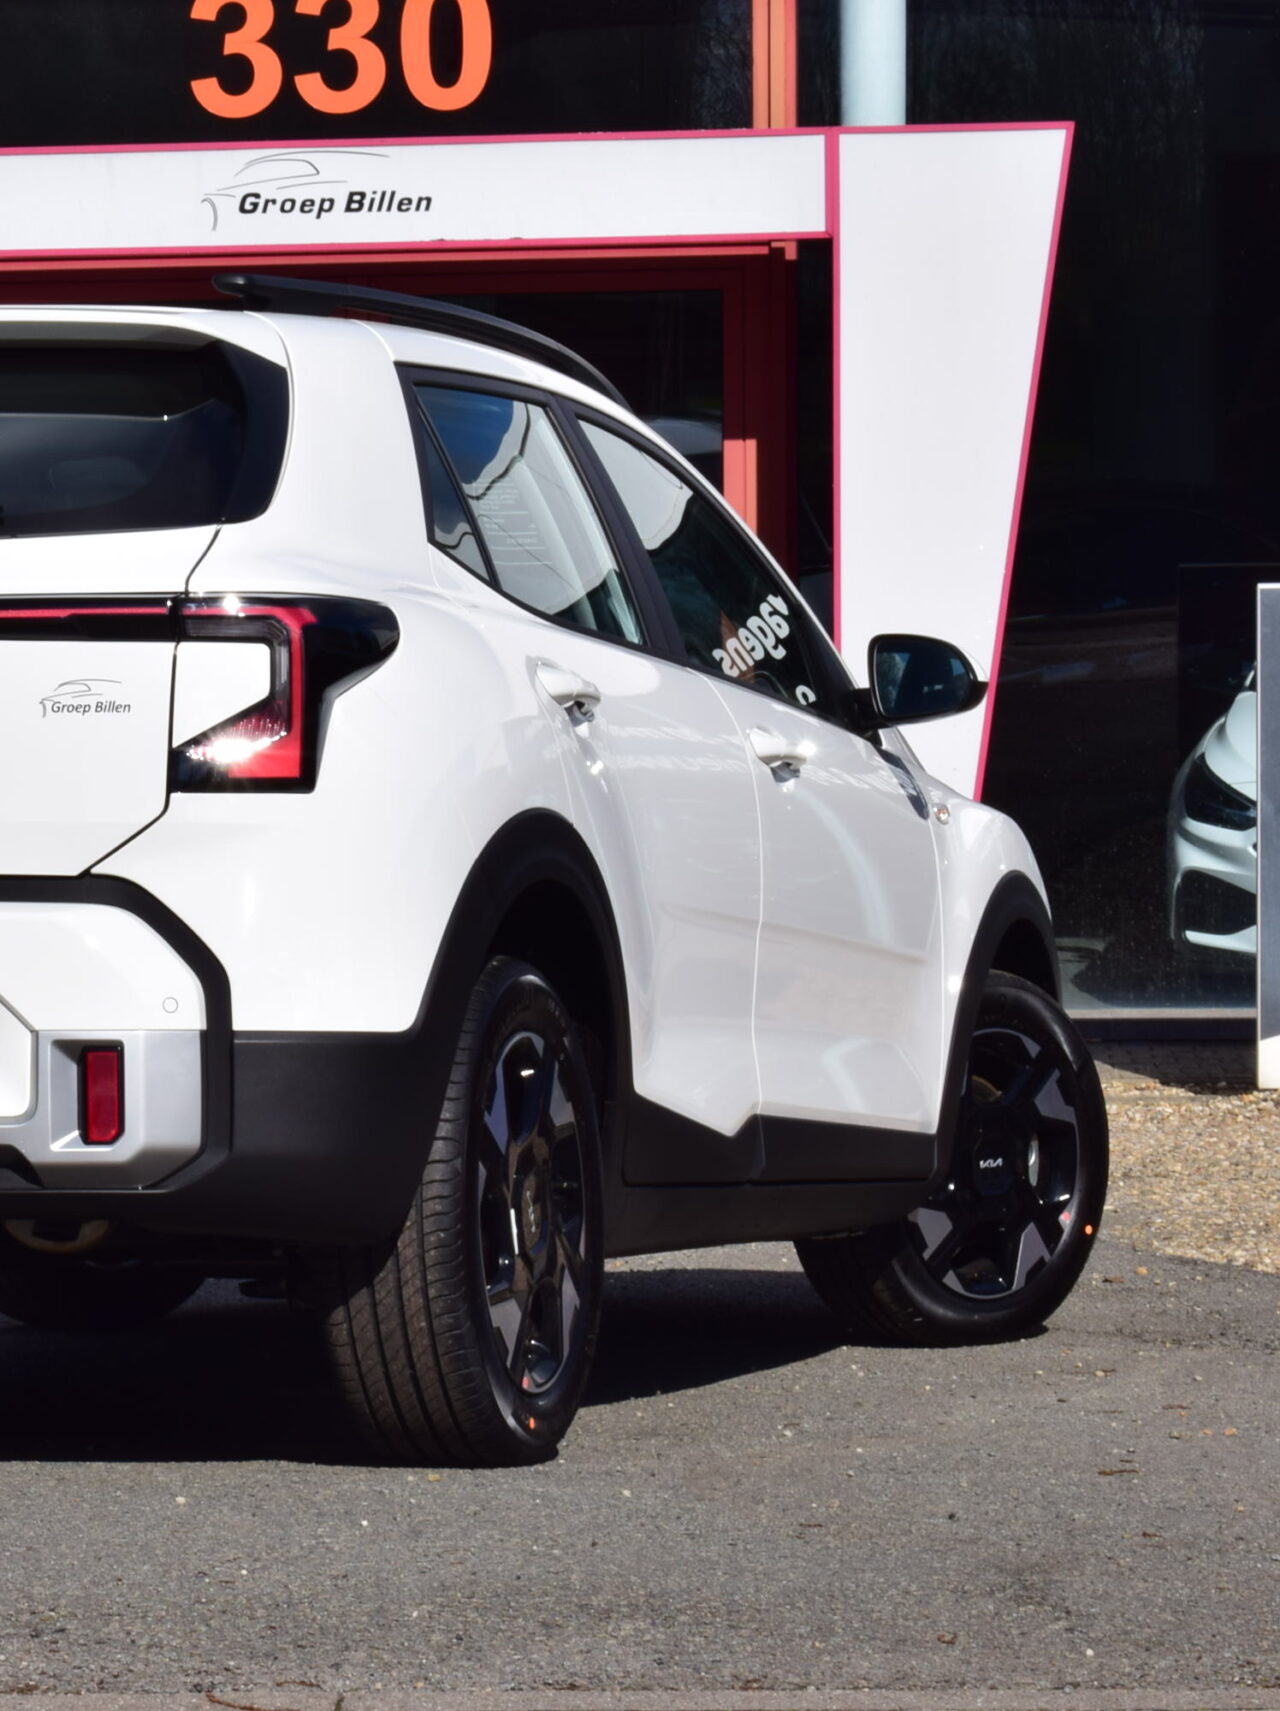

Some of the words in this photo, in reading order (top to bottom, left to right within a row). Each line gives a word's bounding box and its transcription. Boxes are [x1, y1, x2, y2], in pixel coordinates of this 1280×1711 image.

[190, 0, 493, 119] 330
[238, 191, 335, 219] Groep
[344, 190, 433, 213] Billen
[51, 700, 91, 716] Groep
[95, 700, 131, 713] Billen
